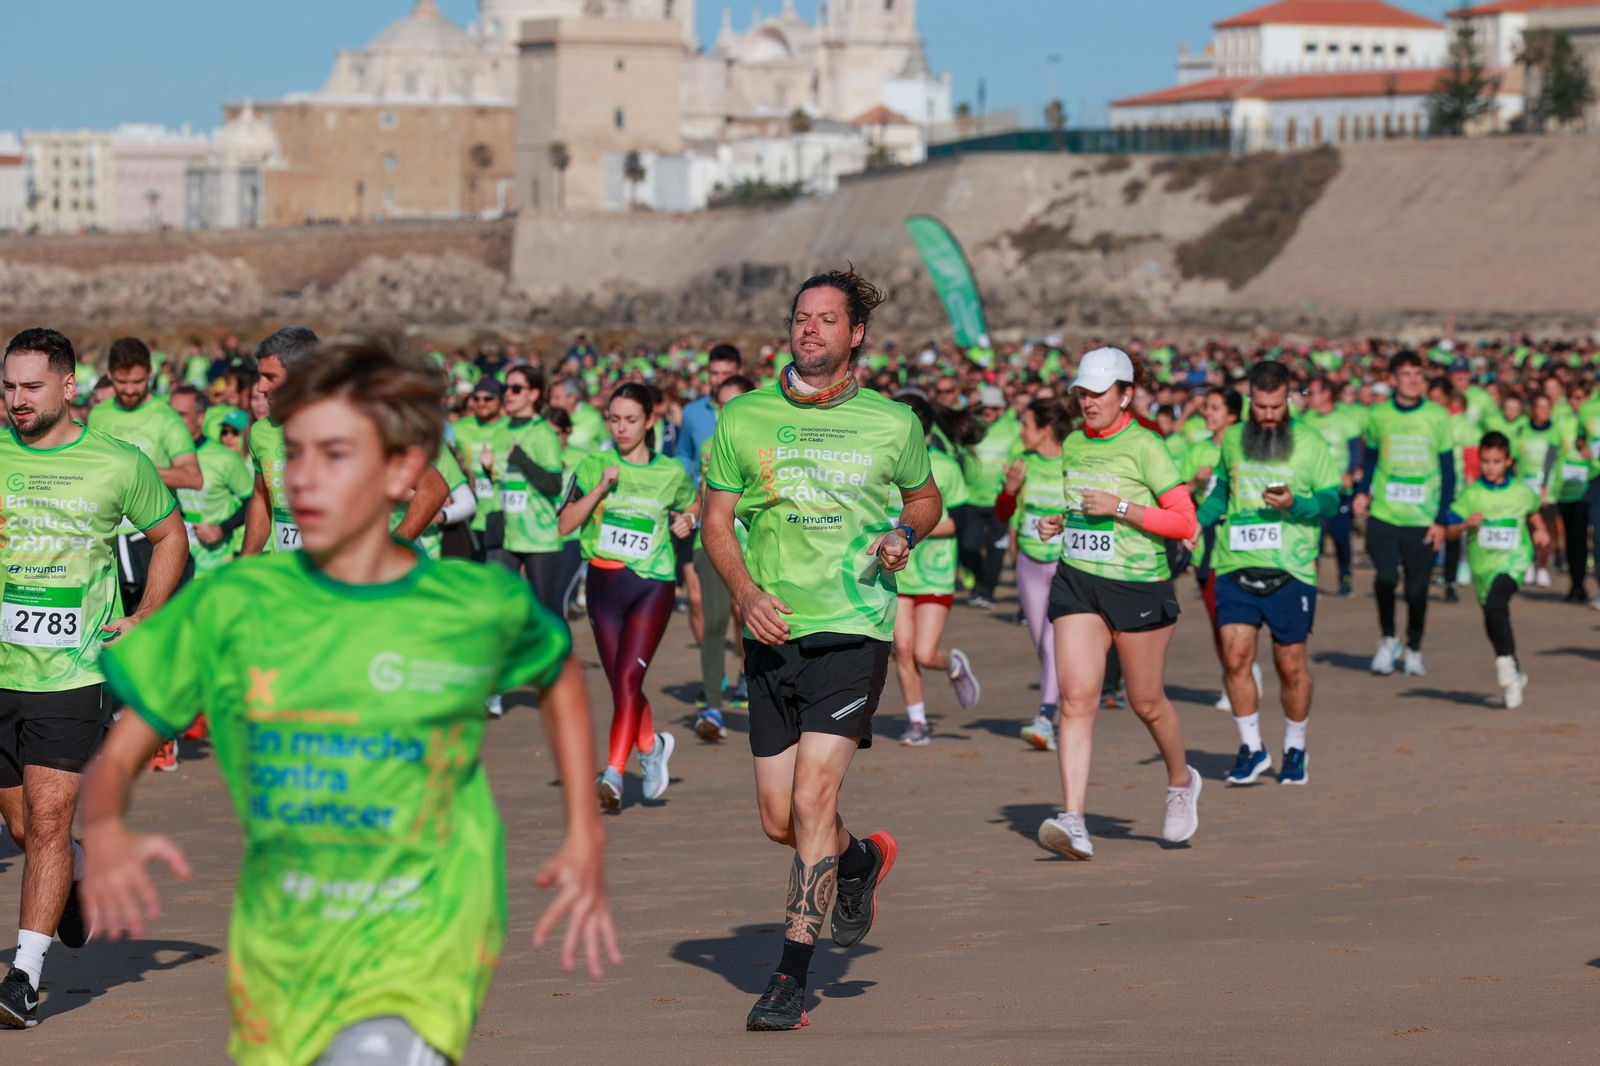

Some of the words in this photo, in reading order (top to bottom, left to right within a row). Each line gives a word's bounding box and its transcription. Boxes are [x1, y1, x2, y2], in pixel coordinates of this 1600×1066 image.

[777, 446, 799, 459] En
[804, 449, 872, 467] marcha
[777, 465, 846, 484] contra
[848, 470, 867, 487] el
[780, 480, 867, 504] cáncer
[6, 494, 28, 509] En
[33, 497, 98, 513] marcha
[8, 512, 74, 530] contra
[76, 516, 92, 532] el
[803, 515, 842, 523] HYUNDAI
[9, 530, 97, 552] cáncer
[611, 530, 649, 551] 1475
[1071, 533, 1111, 551] 2138
[1240, 527, 1278, 542] 1676
[25, 565, 67, 573] HYUNDAI
[15, 610, 77, 635] 2783
